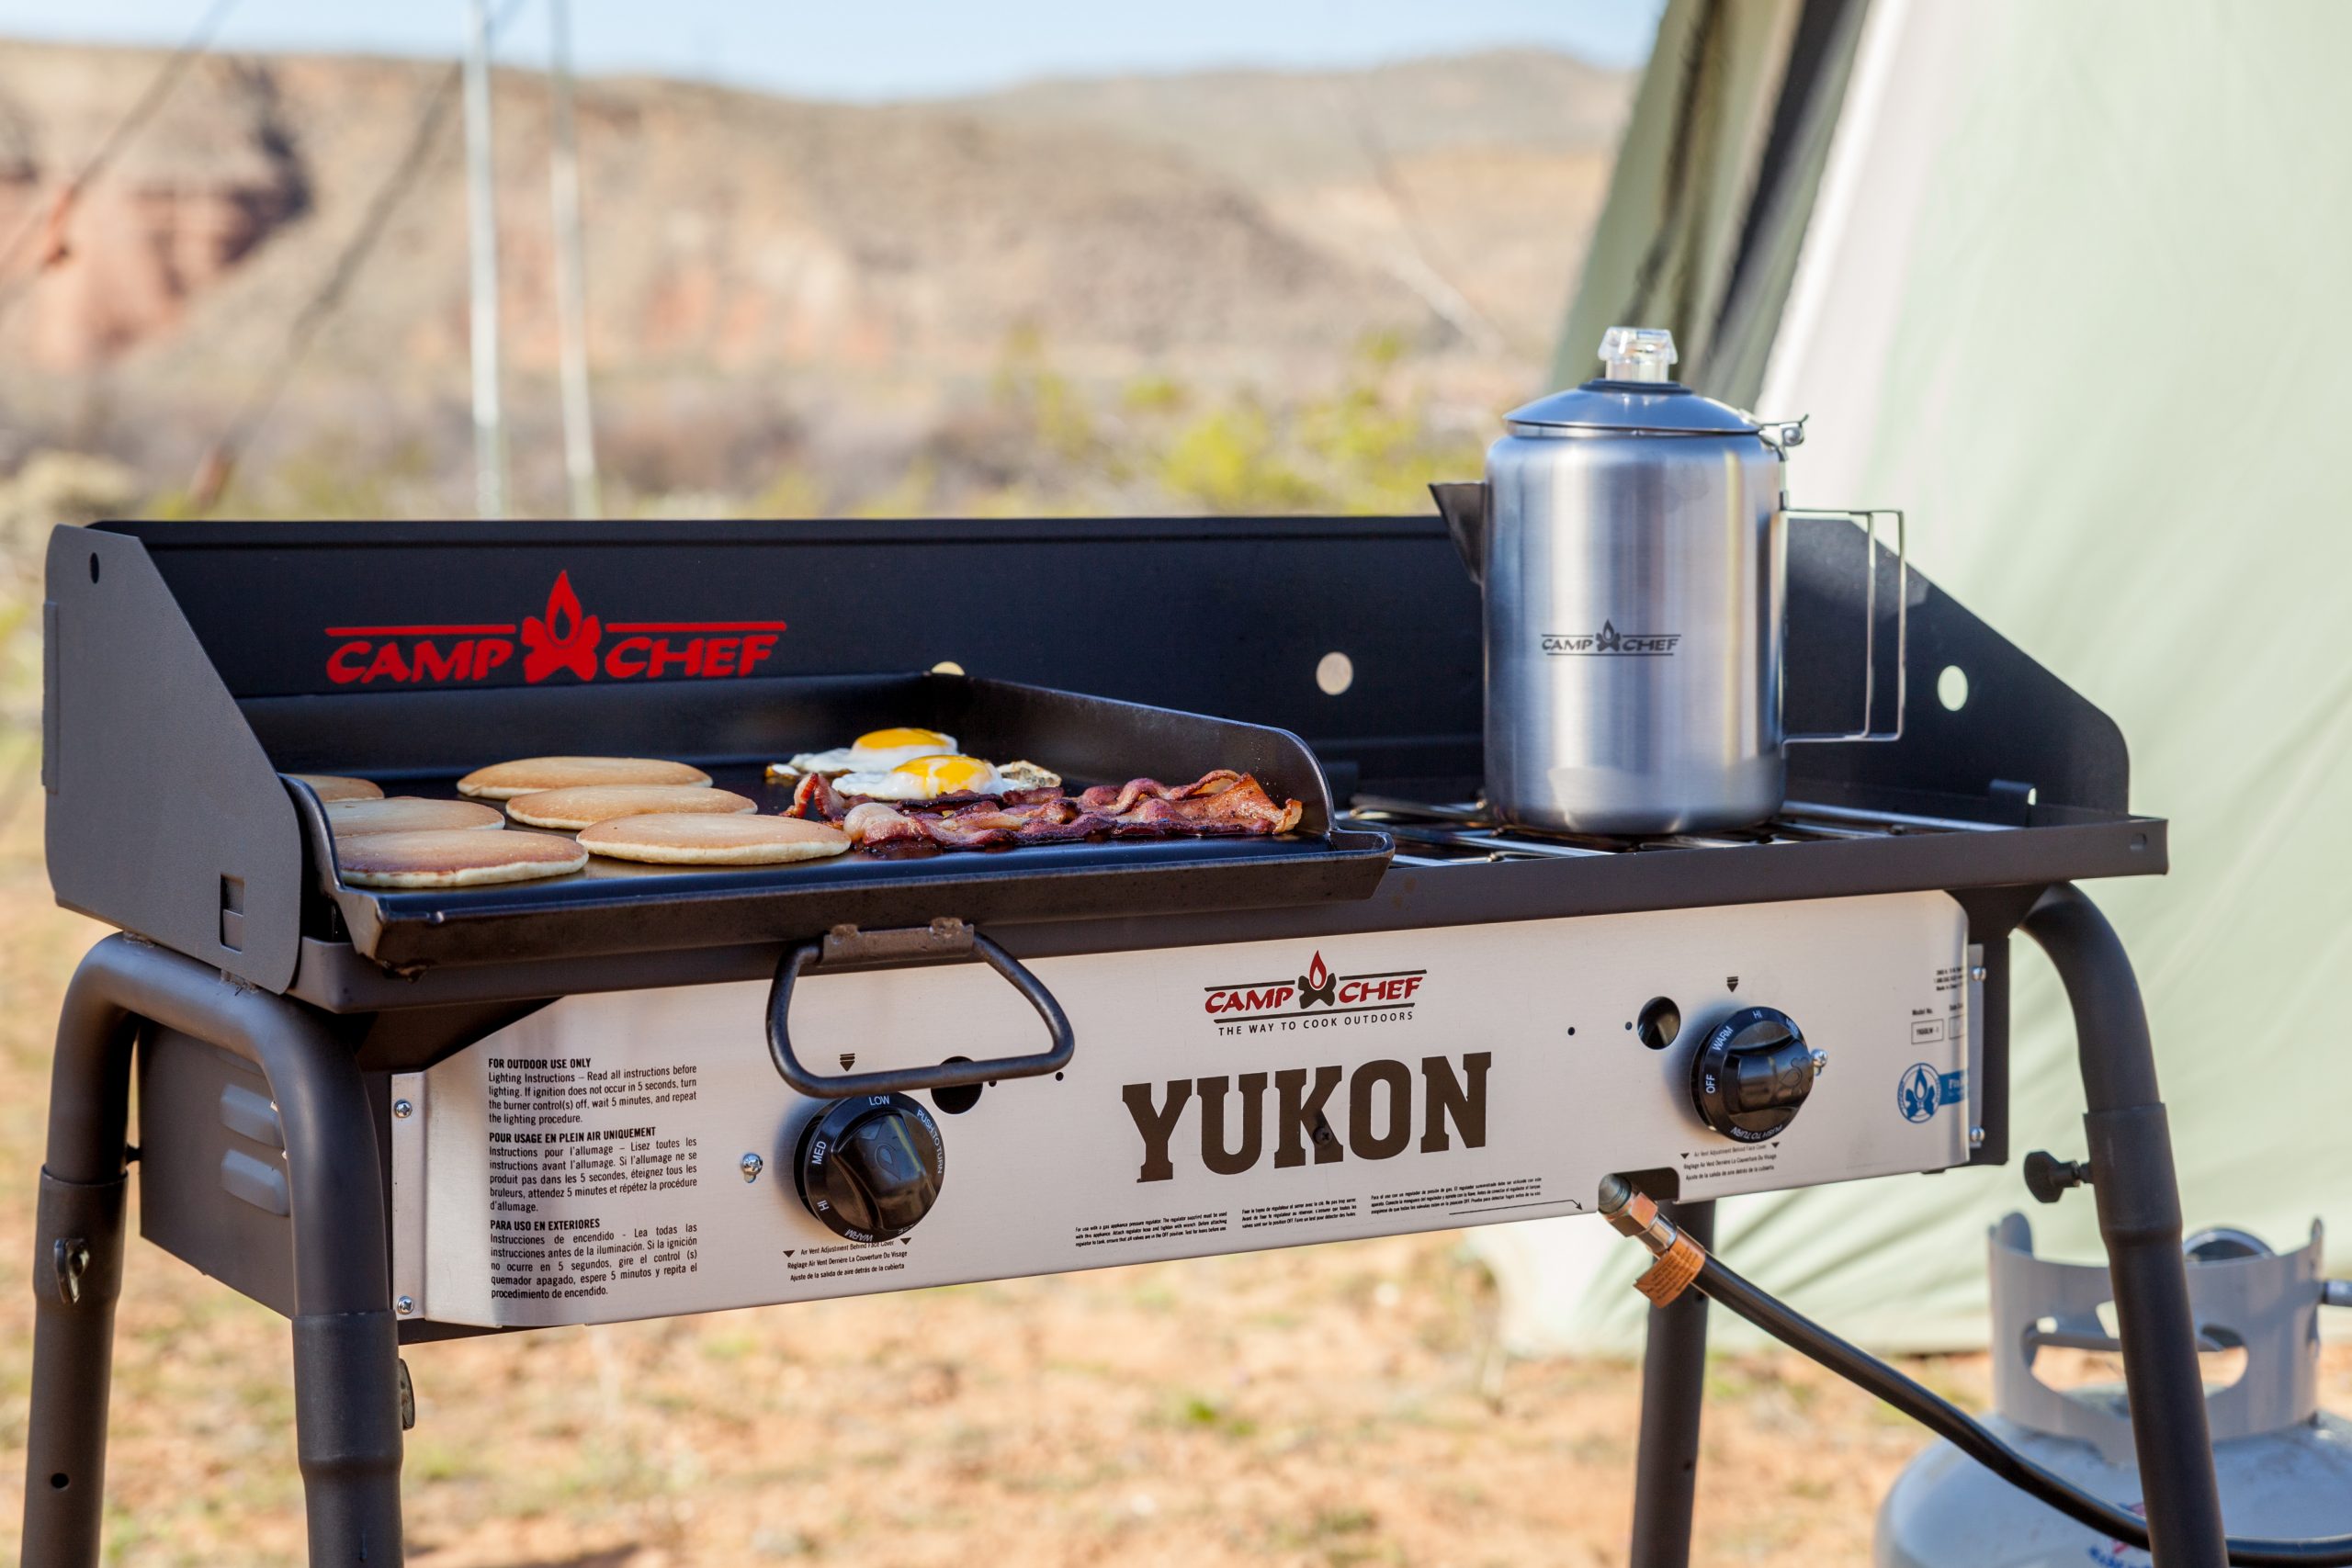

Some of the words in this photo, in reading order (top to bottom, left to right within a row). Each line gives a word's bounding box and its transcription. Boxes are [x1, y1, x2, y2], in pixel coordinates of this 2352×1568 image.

[1542, 638, 1593, 650] CAMP
[1623, 638, 1679, 650] CHEF
[325, 639, 514, 684] CAMP
[605, 635, 779, 678] CHEF
[1205, 987, 1293, 1013] CAMP
[1339, 976, 1422, 1004] CHEF
[1218, 1026, 1242, 1036] THE
[1250, 1022, 1275, 1033] WAY
[1281, 1021, 1296, 1031] TO
[1303, 1017, 1338, 1029] COOK
[1344, 1010, 1413, 1025] OUTDOORS
[1753, 1010, 1762, 1019] HI
[1713, 1025, 1733, 1051] WARM
[489, 1058, 504, 1068] FOR
[507, 1059, 548, 1069] OUTDOOR
[550, 1059, 567, 1068] USE
[571, 1058, 591, 1068] ONLY
[489, 1072, 522, 1085] Lighting
[525, 1073, 575, 1083] Instructions
[587, 1071, 607, 1080] Read
[611, 1070, 620, 1079] all
[624, 1067, 670, 1078] instructions
[673, 1065, 696, 1074] before
[1706, 1074, 1715, 1093] OFF
[525, 1088, 531, 1097] If
[533, 1086, 565, 1098] ignition
[568, 1086, 586, 1096] does
[590, 1084, 602, 1094] not
[605, 1083, 626, 1093] occur
[628, 1082, 635, 1091] in
[638, 1081, 642, 1090] 5
[681, 1078, 696, 1088] turn
[489, 1100, 501, 1110] the
[504, 1100, 530, 1111] burner
[533, 1100, 573, 1111] control(s)
[592, 1097, 608, 1107] wait
[611, 1098, 616, 1106] 5
[655, 1094, 670, 1102] and
[673, 1091, 696, 1102] repeat
[869, 1096, 889, 1105] LOW
[489, 1114, 501, 1123] the
[504, 1114, 536, 1125] lighting
[917, 1109, 934, 1132] PUSH
[1122, 1052, 1491, 1183] YUKON
[490, 1133, 511, 1143] POUR
[514, 1133, 542, 1144] USAGE
[546, 1134, 556, 1143] EN
[560, 1132, 584, 1142] PLEIN
[587, 1131, 601, 1141] AIR
[604, 1126, 656, 1140] UNIQUEMENT
[932, 1131, 940, 1145] TO
[490, 1146, 537, 1157] Instructions
[544, 1149, 563, 1159] pour
[571, 1145, 613, 1157] l'allumage
[630, 1142, 650, 1151] Lisez
[656, 1139, 679, 1149] toutes
[685, 1137, 696, 1146] les
[812, 1141, 826, 1165] MED
[490, 1160, 537, 1170] instructions
[542, 1161, 566, 1170] avant
[619, 1156, 627, 1166] Si
[631, 1153, 672, 1167] l'allumage
[675, 1153, 684, 1161] ne
[688, 1152, 696, 1160] se
[935, 1146, 944, 1174] TURN
[490, 1174, 518, 1185] produit
[522, 1176, 537, 1186] pas
[540, 1174, 561, 1184] dans
[565, 1173, 576, 1183] les
[581, 1173, 585, 1181] 5
[631, 1168, 663, 1181] éteignez
[666, 1166, 683, 1174] tous
[686, 1165, 696, 1173] les
[528, 1189, 564, 1199] attendez
[567, 1189, 572, 1197] 5
[575, 1186, 607, 1196] minutes
[610, 1186, 616, 1194] et
[619, 1183, 647, 1195] répétez
[650, 1181, 657, 1190] la
[660, 1179, 696, 1191] procédure
[818, 1200, 829, 1212] HI
[491, 1220, 512, 1231] PARA
[514, 1221, 531, 1231] USO
[535, 1221, 546, 1231] EN
[548, 1218, 600, 1231] EXTERIORES
[491, 1234, 545, 1245] Instrucciones
[554, 1235, 564, 1244] de
[573, 1232, 614, 1243] encendido
[634, 1228, 648, 1237] Lea
[656, 1225, 677, 1235] todas
[685, 1224, 696, 1232] las
[845, 1229, 873, 1242] WARM
[491, 1248, 545, 1258] instrucciones
[548, 1247, 571, 1258] antes
[574, 1247, 584, 1256] de
[586, 1247, 594, 1255] la
[647, 1240, 654, 1249] Si
[657, 1239, 664, 1248] la
[667, 1237, 696, 1249] ignición
[492, 1263, 500, 1271] no
[507, 1263, 533, 1271] ocurre
[540, 1263, 550, 1271] en
[558, 1262, 563, 1270] 5
[619, 1258, 633, 1268] gire
[640, 1255, 647, 1264] el
[653, 1252, 680, 1262] control
[687, 1249, 697, 1260] (s)
[492, 1276, 531, 1288] quemador
[581, 1273, 606, 1285] espere
[611, 1270, 616, 1280] 5
[620, 1268, 651, 1279] minutos
[655, 1269, 660, 1278] y
[663, 1265, 686, 1277] repita
[690, 1263, 697, 1271] el
[492, 1289, 549, 1300] procedimiento
[552, 1289, 561, 1298] de
